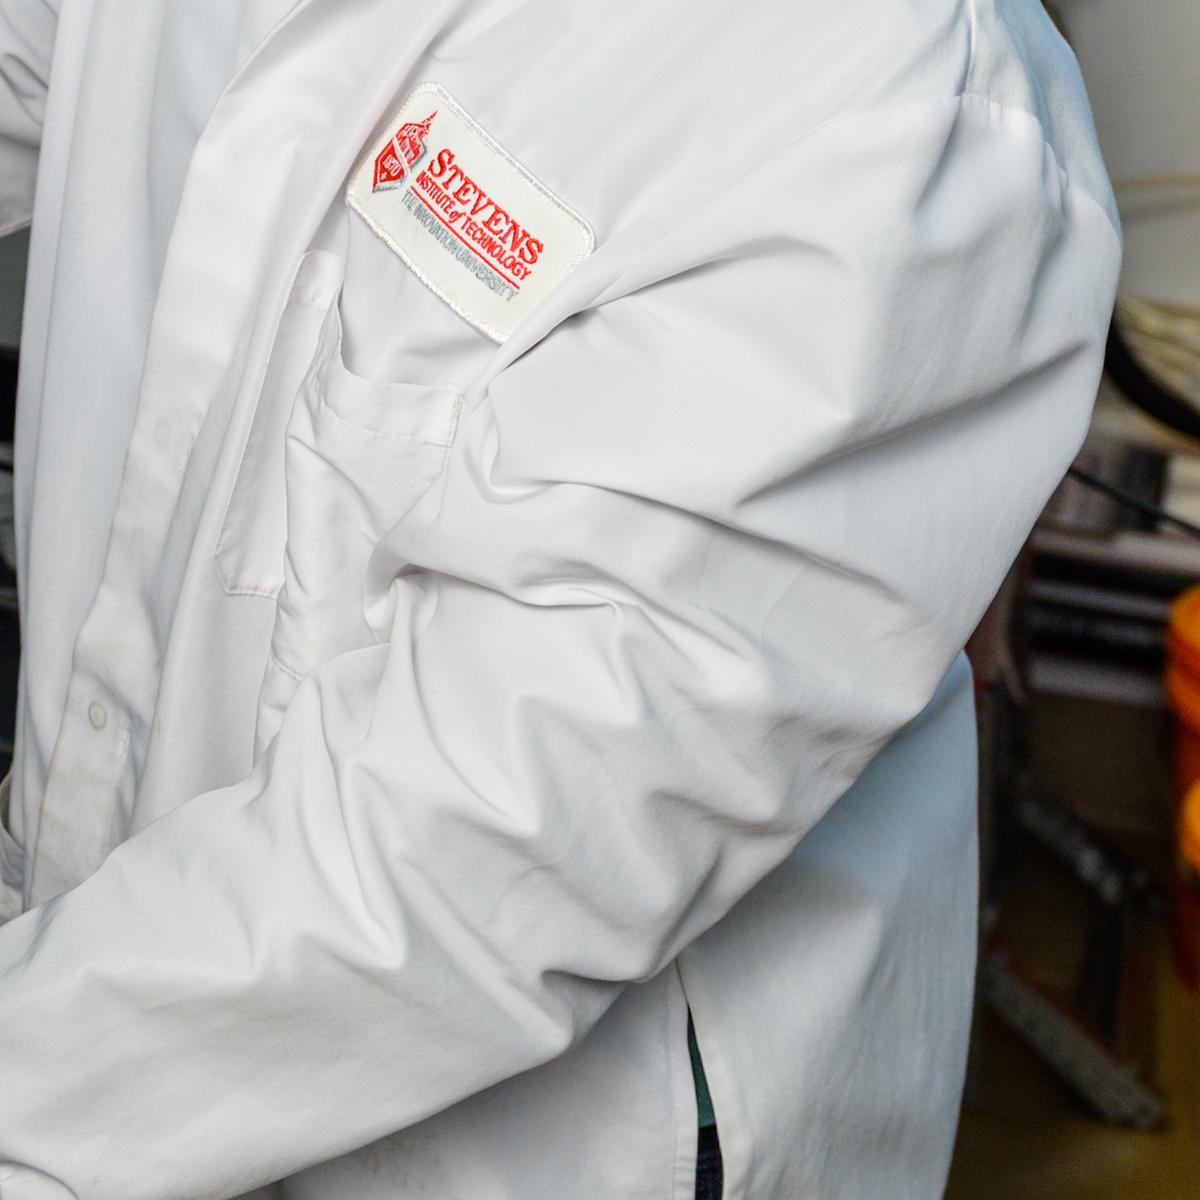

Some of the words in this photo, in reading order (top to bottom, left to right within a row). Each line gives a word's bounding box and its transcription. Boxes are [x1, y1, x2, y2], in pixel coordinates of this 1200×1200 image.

[401, 190, 417, 212] THE
[416, 170, 456, 214] INSTITUTE
[448, 210, 467, 223] of
[461, 216, 532, 281] TECHNOLOGY
[427, 148, 544, 264] STEVENS
